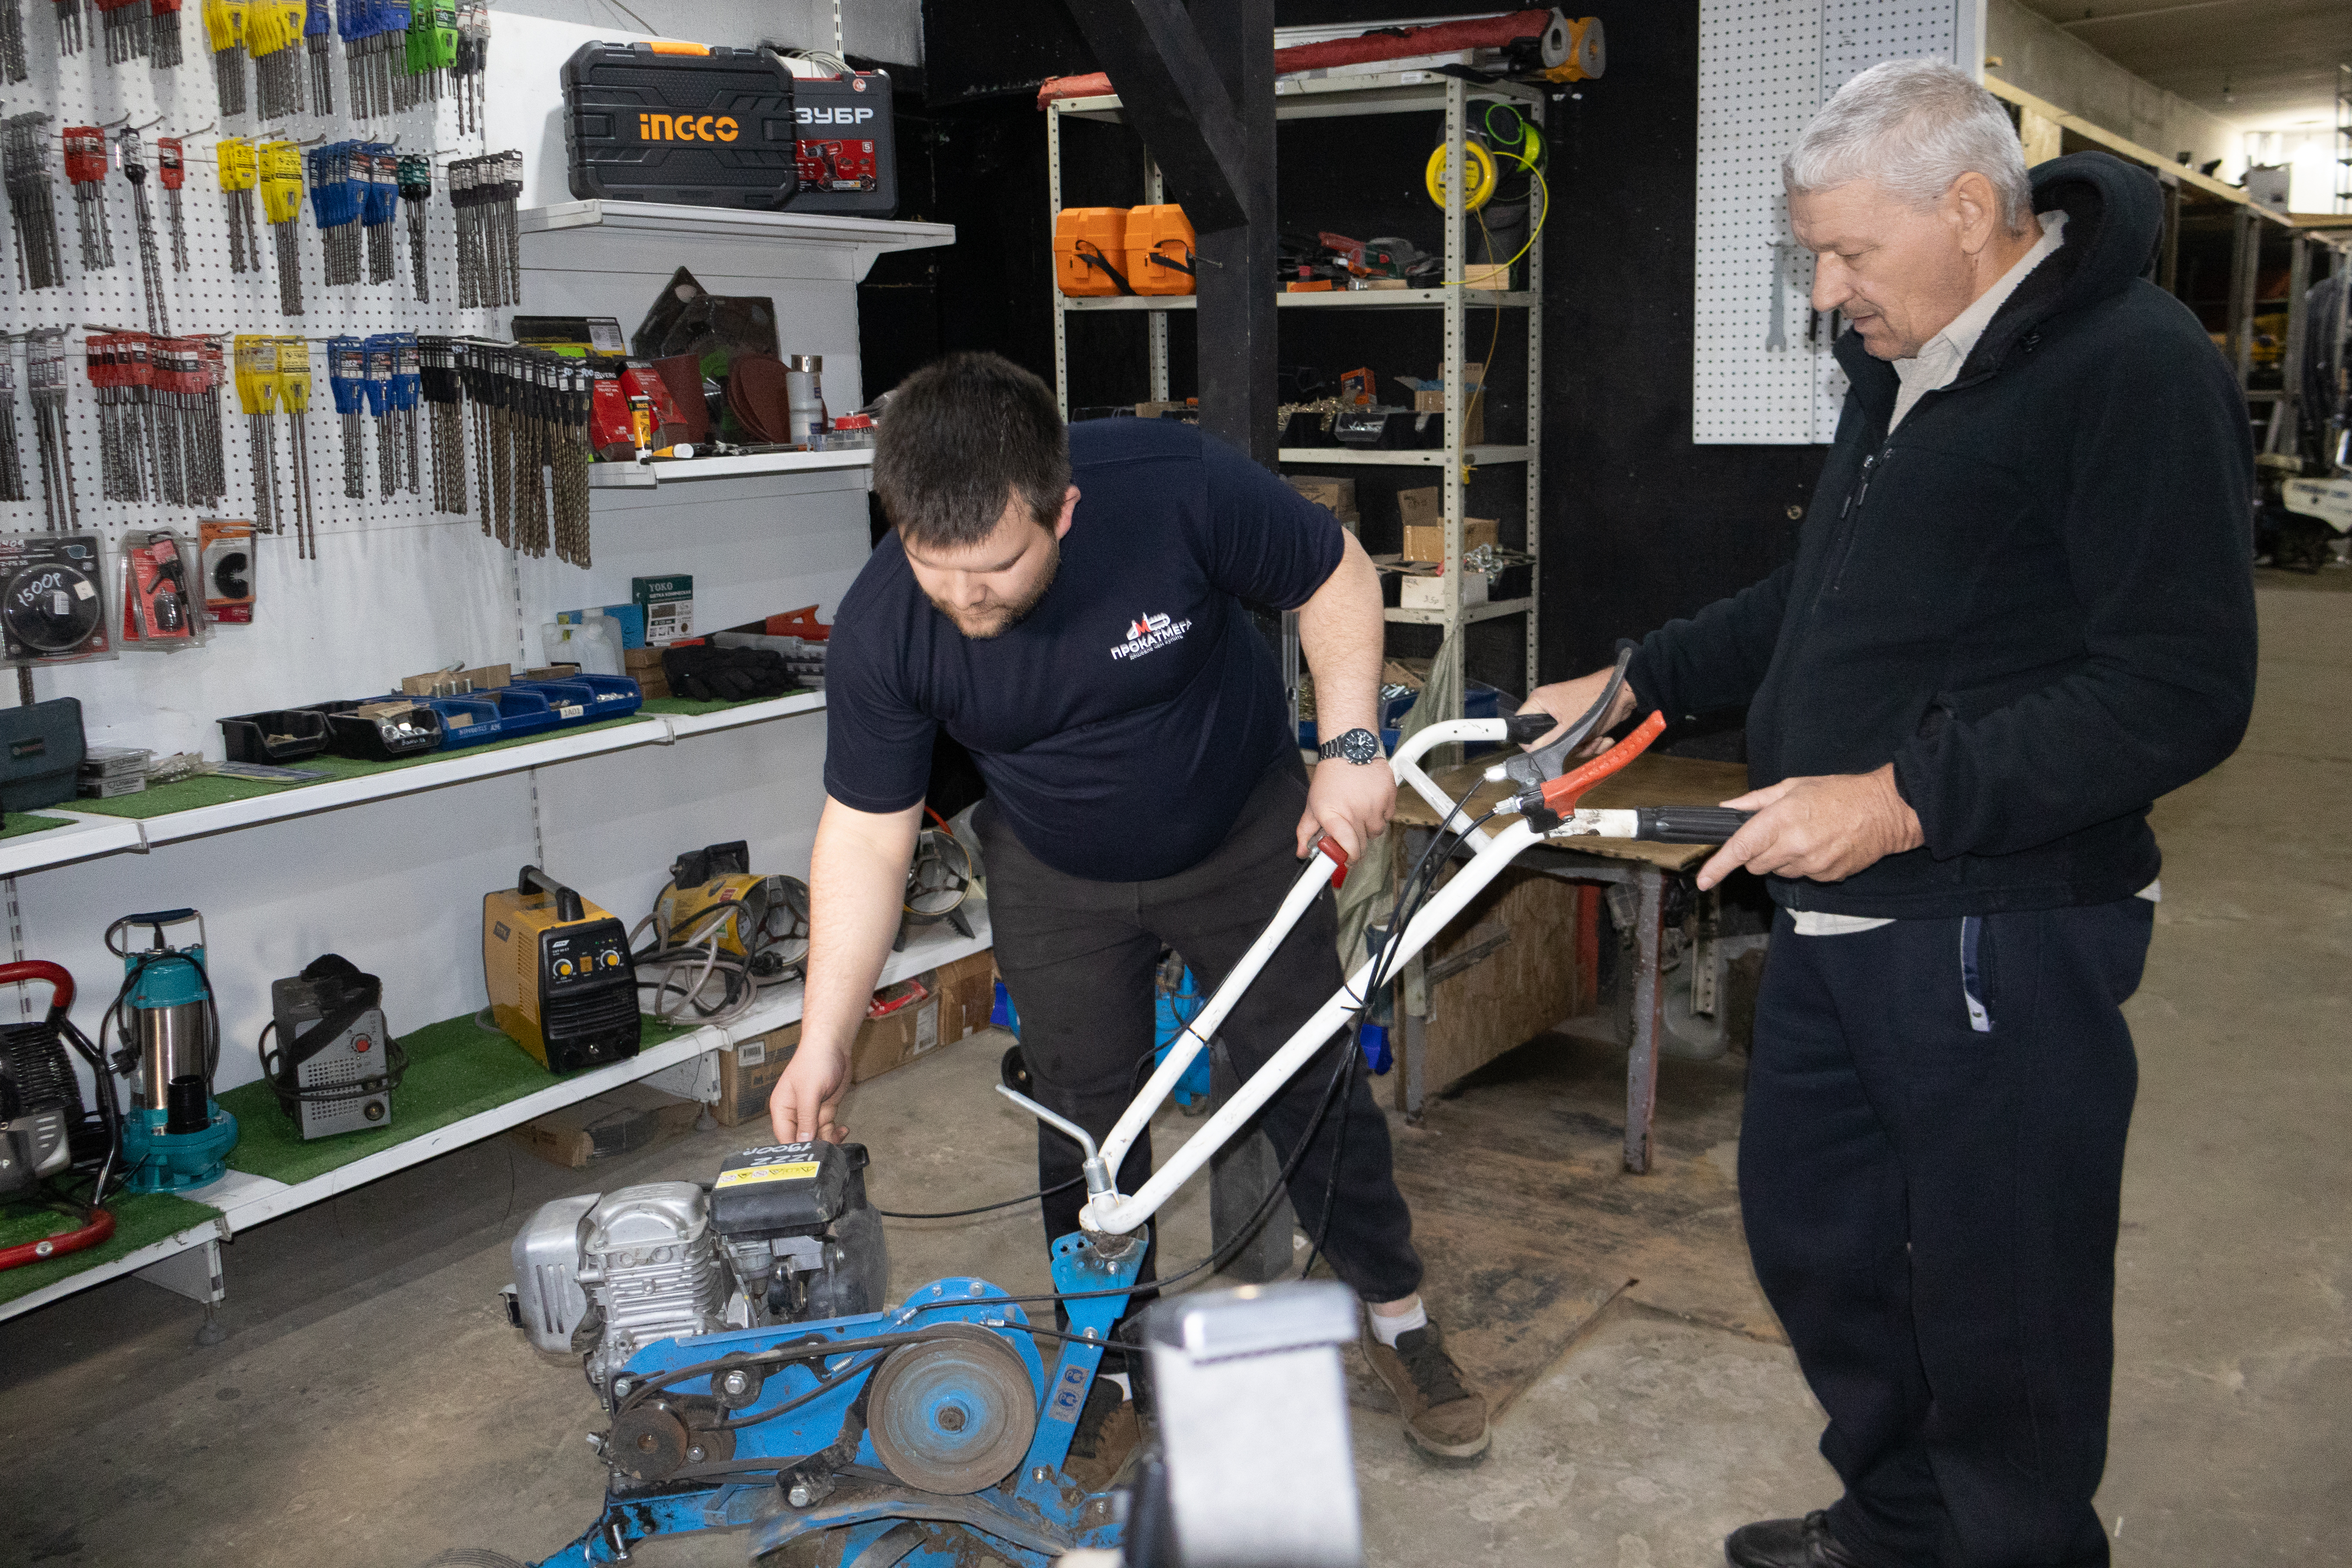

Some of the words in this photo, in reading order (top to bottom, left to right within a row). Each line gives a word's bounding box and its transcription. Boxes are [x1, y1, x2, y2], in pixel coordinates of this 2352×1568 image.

[795, 107, 874, 124] ЗУБР
[649, 582, 673, 592] YOKO
[1110, 618, 1193, 660] ПРОКАТМЕГА
[564, 707, 582, 717] 1A01
